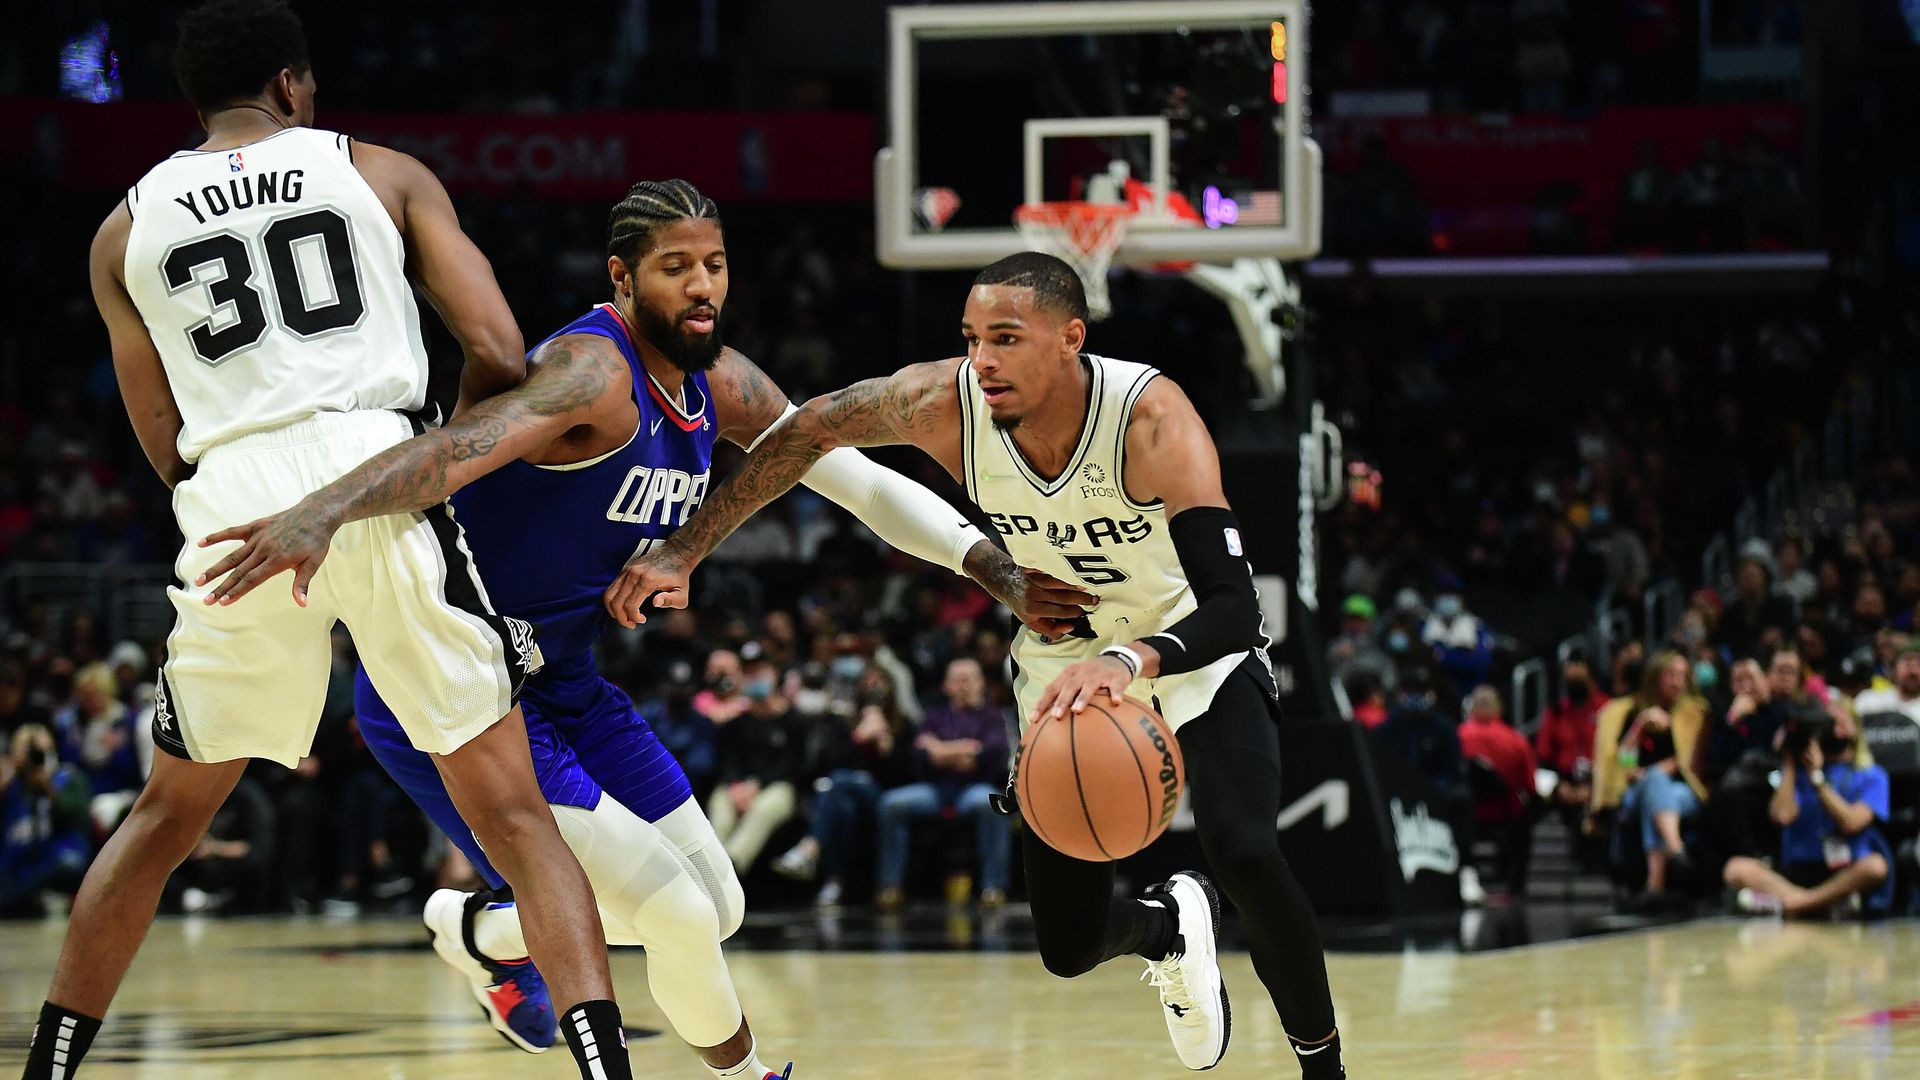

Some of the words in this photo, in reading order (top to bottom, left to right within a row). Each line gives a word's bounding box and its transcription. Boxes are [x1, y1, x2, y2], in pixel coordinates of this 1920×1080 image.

[174, 169, 304, 224] YOUNG
[158, 204, 370, 368] 30
[606, 465, 711, 527] CLIPPE
[1080, 485, 1120, 500] Frost
[985, 510, 1152, 549] SPURS
[1058, 553, 1132, 588] 5
